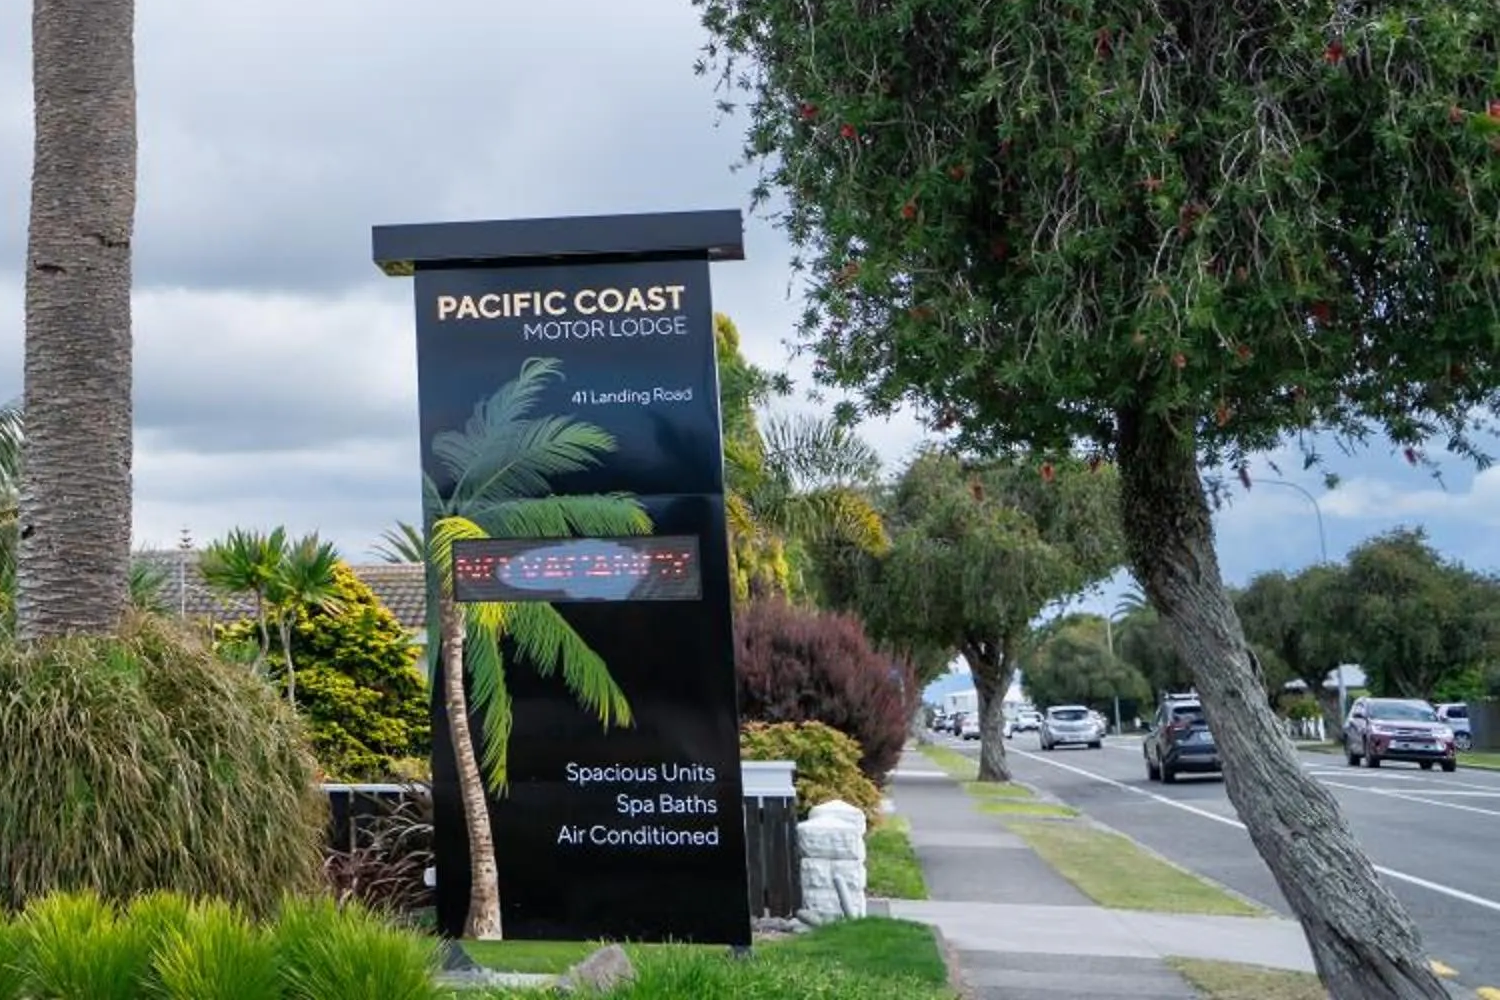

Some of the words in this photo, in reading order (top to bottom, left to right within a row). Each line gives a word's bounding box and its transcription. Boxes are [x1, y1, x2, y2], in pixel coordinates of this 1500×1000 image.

[438, 291, 567, 320] PACIFIC
[574, 285, 686, 315] COAST
[523, 319, 605, 341] MOTOR
[609, 316, 688, 337] LODGE
[572, 390, 588, 404] 41
[591, 388, 651, 406] Landing
[653, 386, 693, 401] Road
[565, 762, 657, 787] Spacious
[661, 763, 716, 782] Units
[616, 793, 655, 817] Spa
[659, 794, 718, 814] Baths
[557, 825, 586, 845] Air
[589, 824, 719, 846] Conditioned
